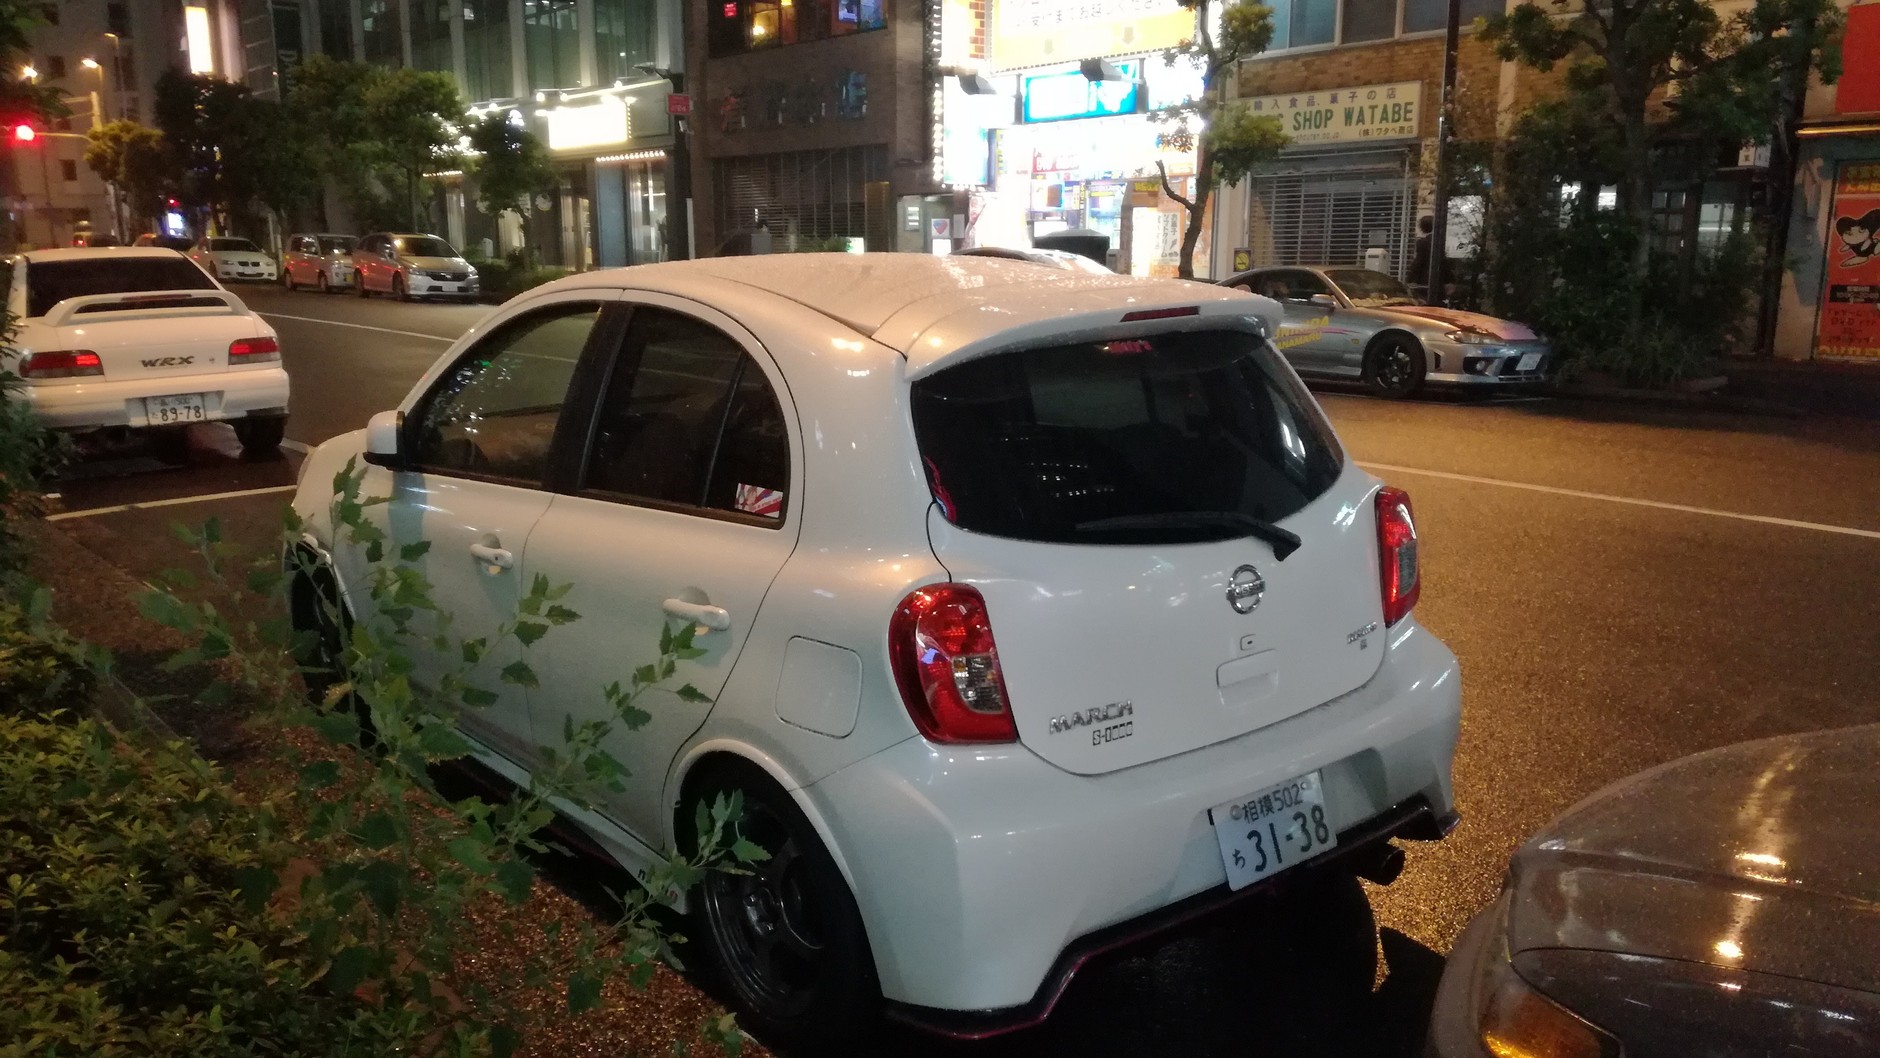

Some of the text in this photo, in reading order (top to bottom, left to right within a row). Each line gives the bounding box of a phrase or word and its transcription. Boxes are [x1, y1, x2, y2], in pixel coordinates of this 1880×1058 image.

[1292, 109, 1334, 131] SHOP
[1344, 101, 1414, 127] WATABE
[141, 355, 195, 368] WRX
[160, 405, 202, 422] 89-78
[1049, 700, 1133, 735] MARCH
[1241, 783, 1304, 824] 相模502
[1232, 804, 1330, 872] ち 31-38
